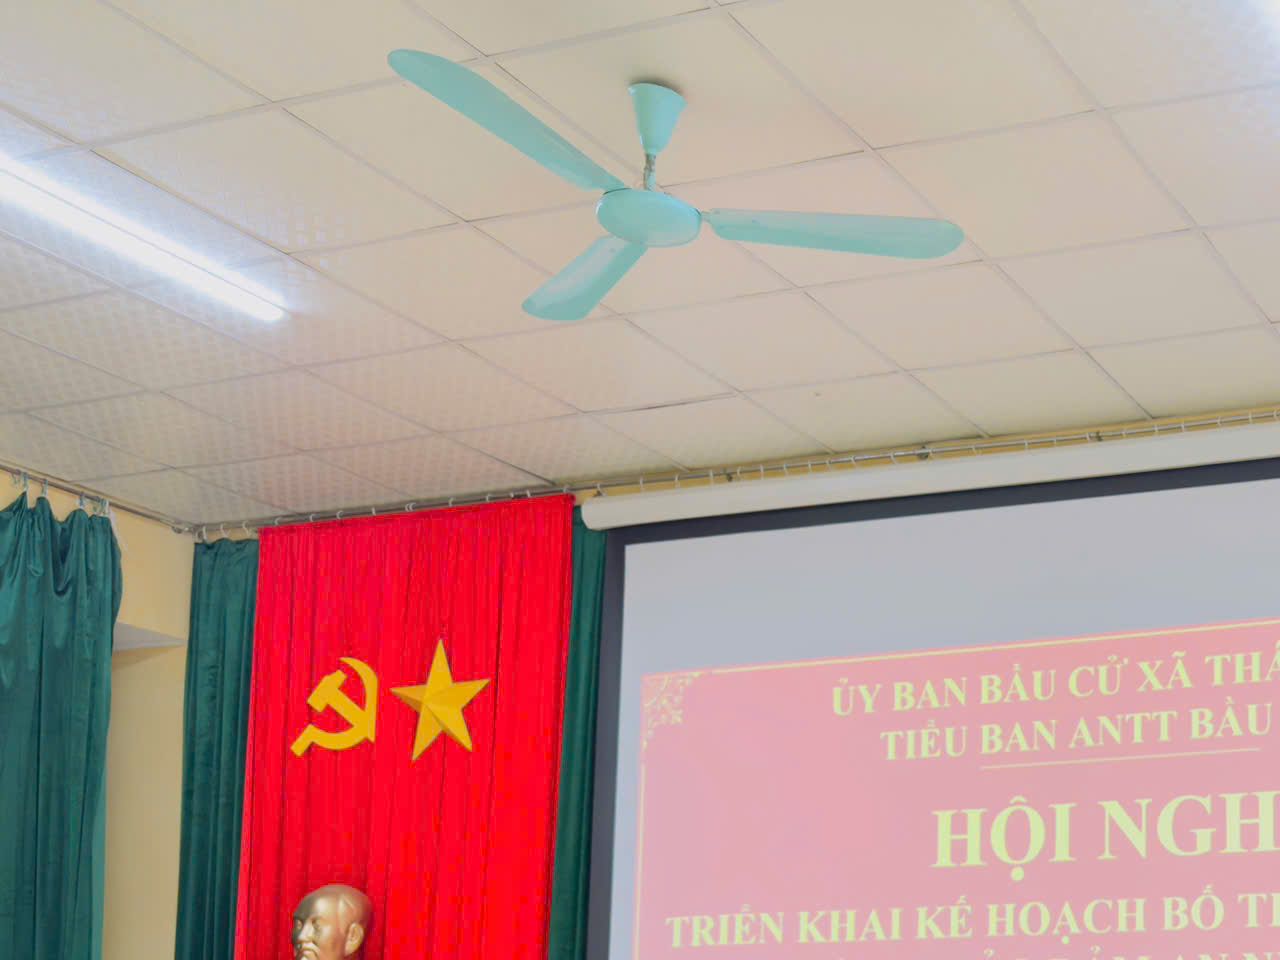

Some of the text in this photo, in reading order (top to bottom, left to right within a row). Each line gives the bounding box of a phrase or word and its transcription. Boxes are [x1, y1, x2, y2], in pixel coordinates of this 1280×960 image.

[831, 676, 883, 718] ỦY
[892, 679, 967, 713] BAN
[979, 663, 1056, 705] BẦU
[1068, 655, 1129, 698] CỬ
[1137, 650, 1193, 692] XÃ
[879, 719, 968, 762] TIỂU
[981, 719, 1058, 755] BAN
[1068, 711, 1177, 748] ANTT
[1191, 695, 1273, 740] BẦU
[930, 794, 1077, 882] HỘI
[665, 903, 785, 948] TRIỂN
[799, 907, 902, 945] KHAI
[916, 895, 973, 940] KẾ
[987, 898, 1145, 945] HOẠCH
[1163, 883, 1225, 931] BỐ
